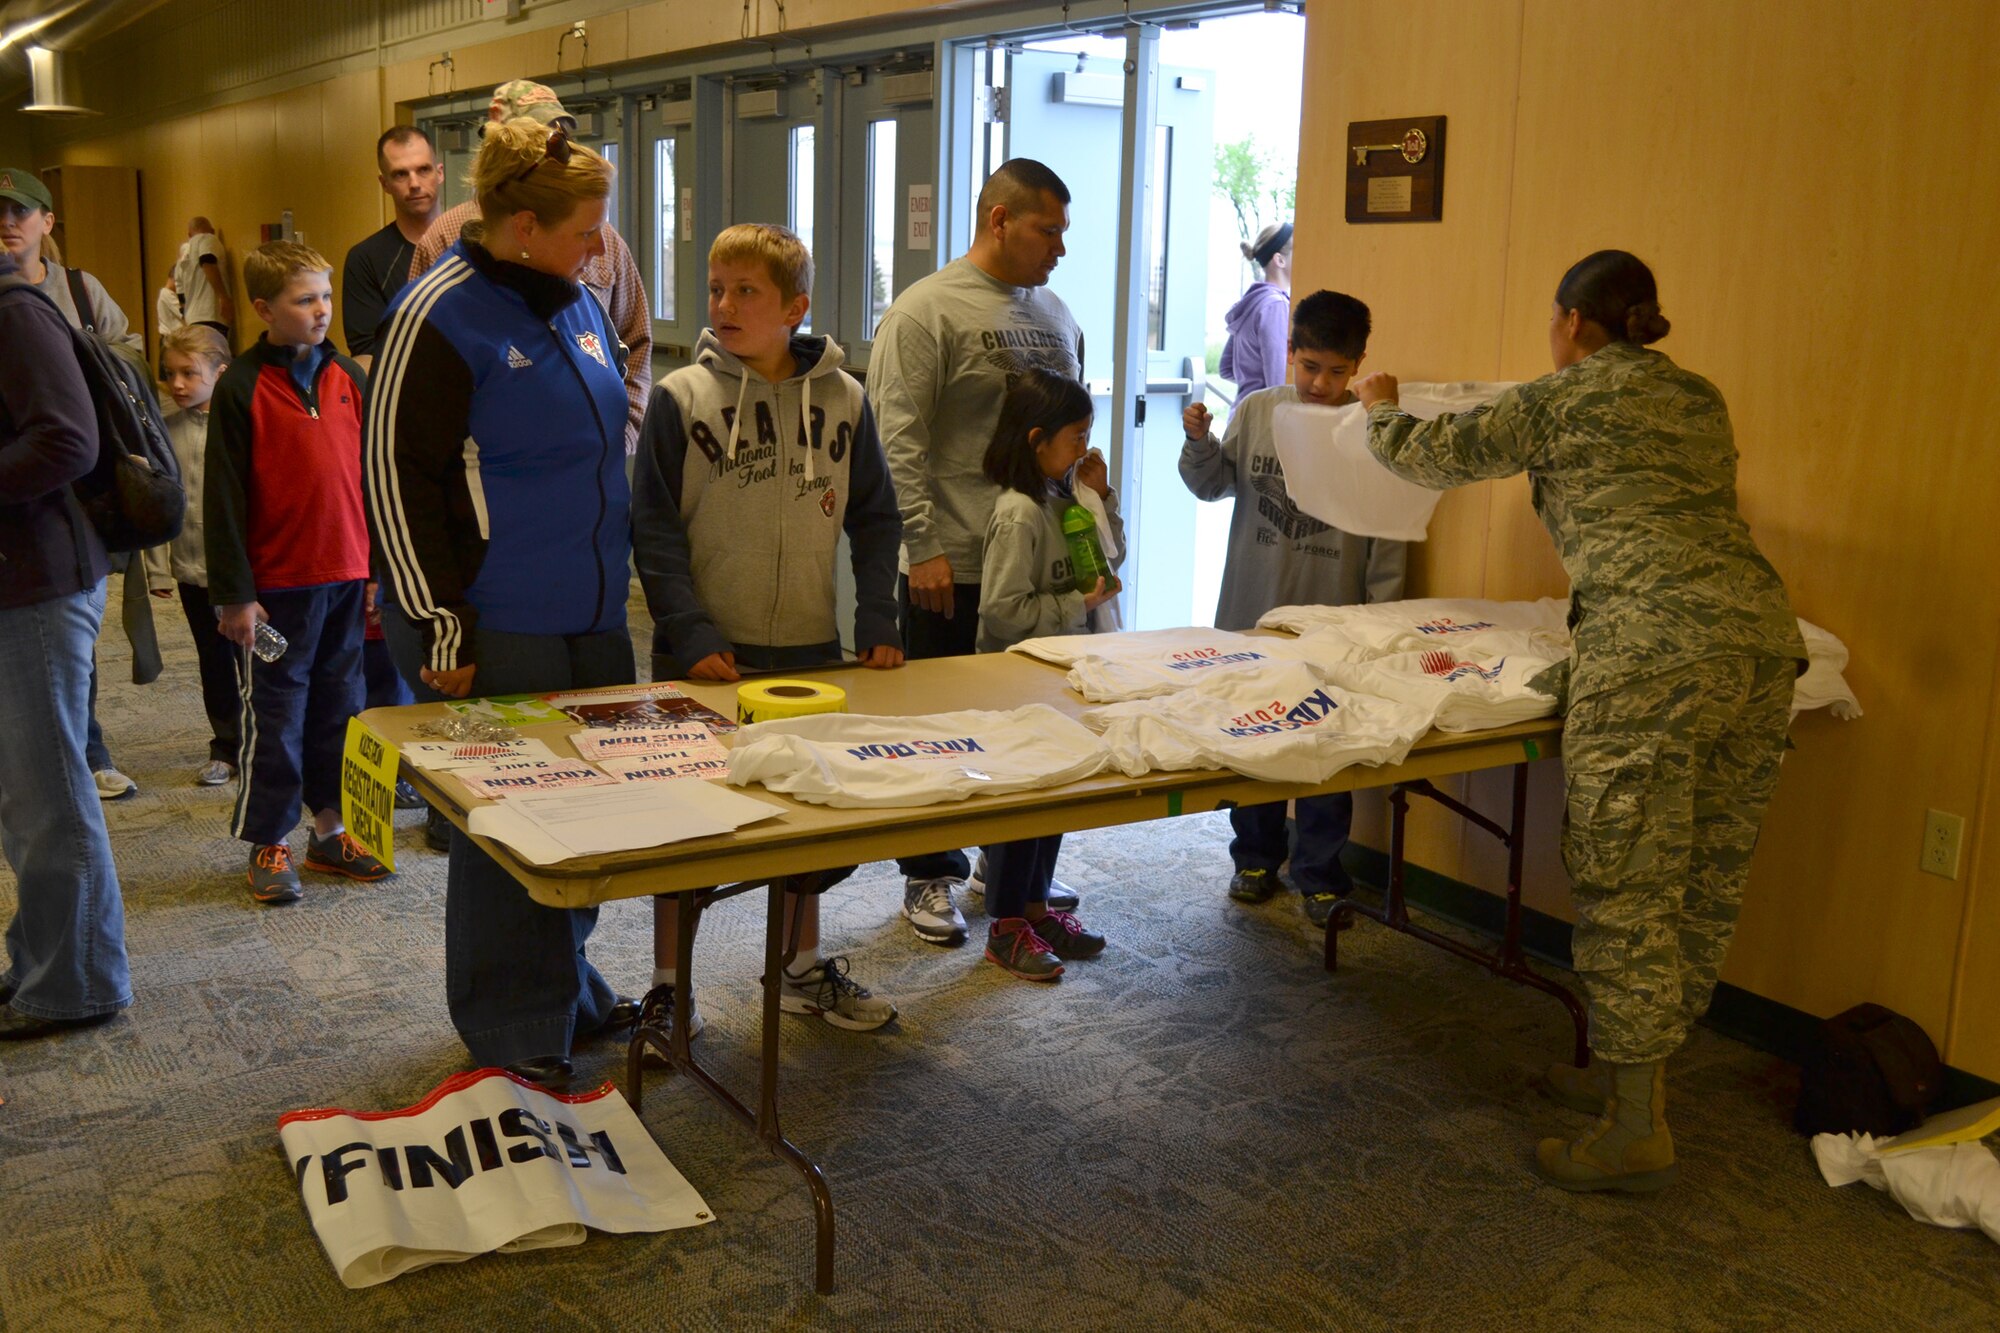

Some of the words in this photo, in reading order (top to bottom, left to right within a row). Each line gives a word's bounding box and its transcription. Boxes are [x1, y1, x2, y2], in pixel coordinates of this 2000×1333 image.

[913, 222, 929, 238] EXIT
[690, 400, 852, 464] BEARS
[1173, 647, 1222, 662] 2013
[1232, 700, 1287, 728] 2013
[1271, 688, 1338, 731] KIDS
[599, 735, 647, 748] RUN
[652, 732, 706, 743] KIDS
[846, 743, 918, 761] RUN
[911, 737, 985, 755] KIDS
[533, 760, 550, 769] 2
[638, 751, 677, 763] MILE
[490, 762, 531, 772] MILE
[624, 767, 676, 781] RUN
[482, 776, 537, 788] RUN
[538, 769, 598, 783] KIDS
[343, 756, 393, 827] REGISTRATION
[351, 799, 385, 859] CHECK-IN
[320, 1107, 627, 1207] FINISH
